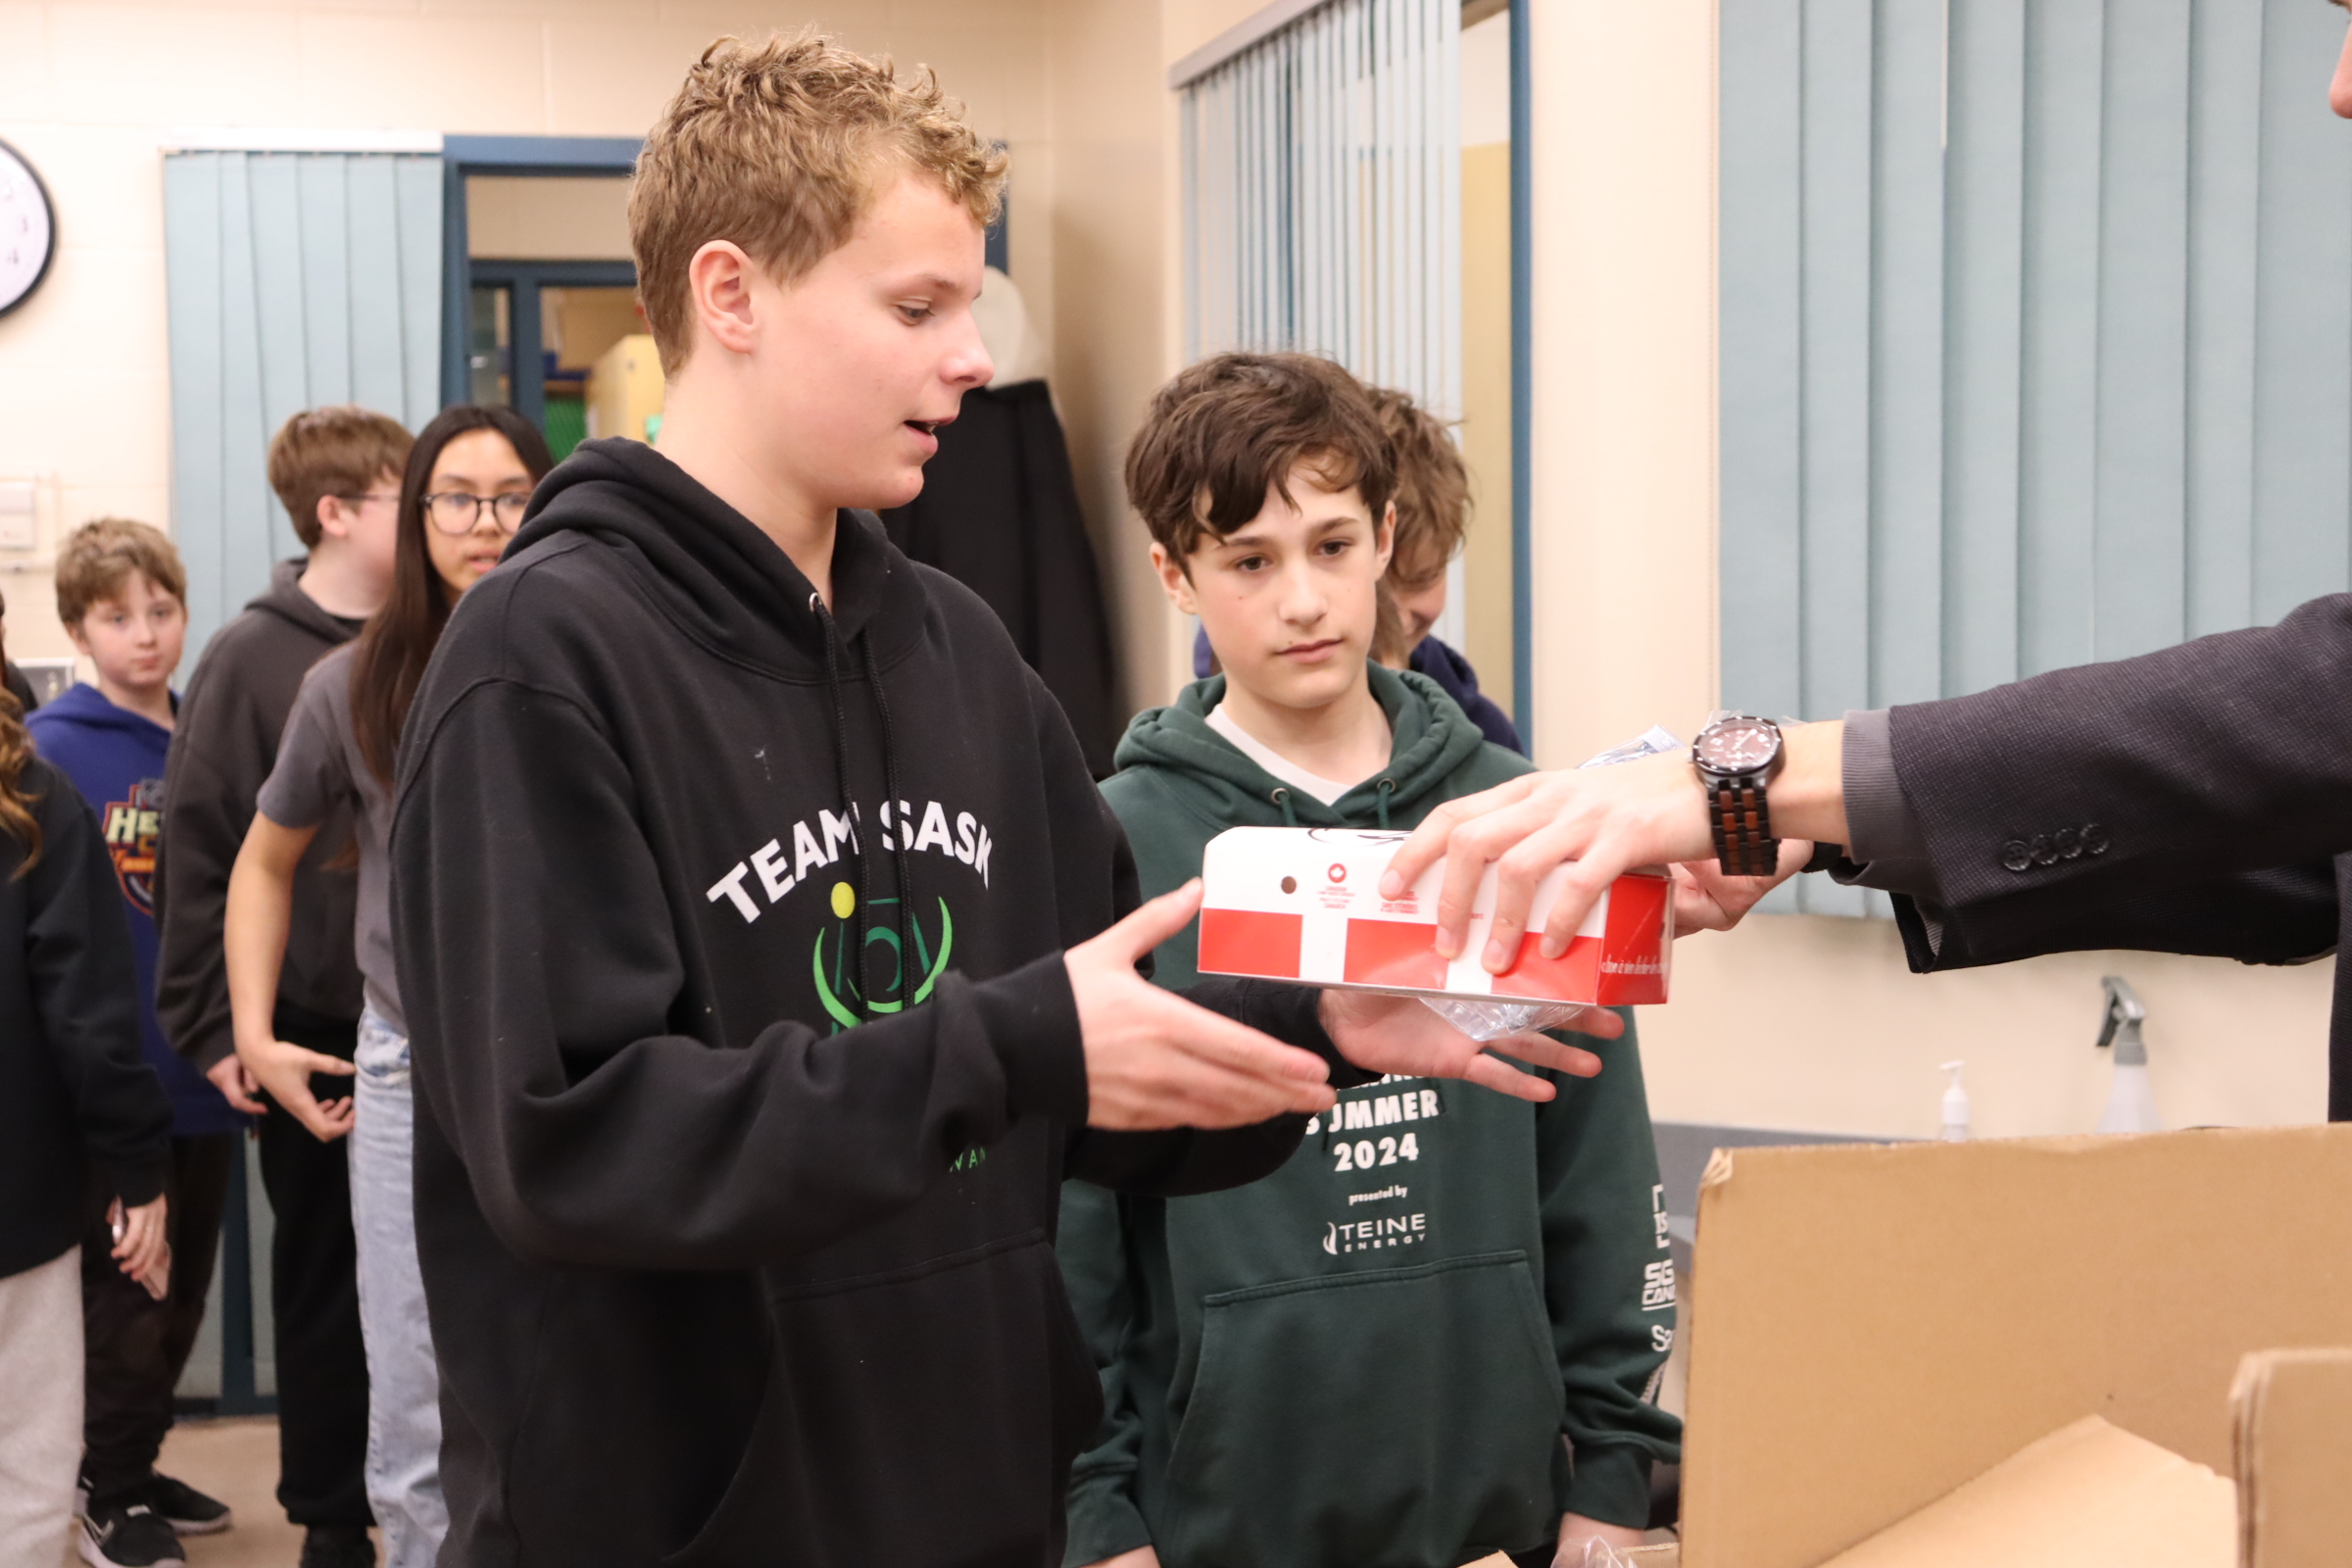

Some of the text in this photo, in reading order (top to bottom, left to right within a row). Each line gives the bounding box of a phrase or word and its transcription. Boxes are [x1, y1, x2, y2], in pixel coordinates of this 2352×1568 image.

[706, 799, 992, 923] TEAM SASK
[1334, 1133, 1419, 1172] 2024
[1348, 1184, 1408, 1206] presented by
[1339, 1213, 1426, 1241] TEINE
[1345, 1233, 1426, 1252] ENERGY
